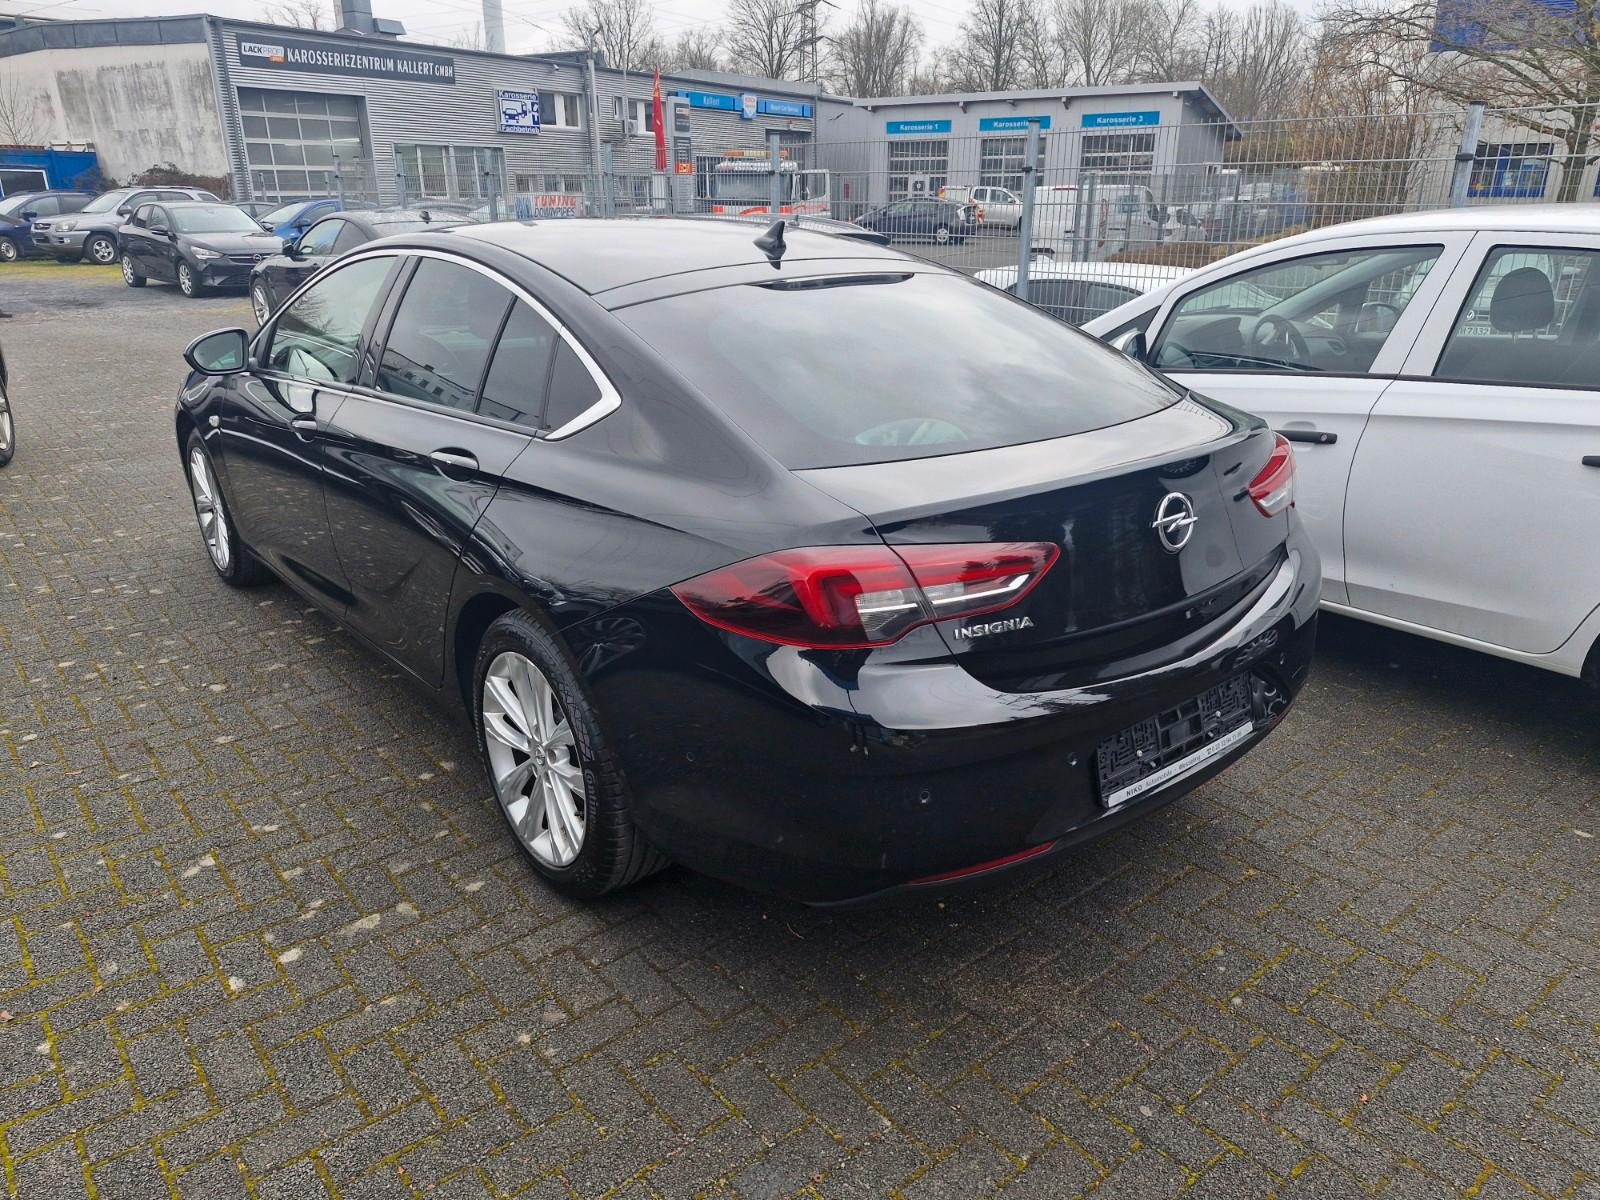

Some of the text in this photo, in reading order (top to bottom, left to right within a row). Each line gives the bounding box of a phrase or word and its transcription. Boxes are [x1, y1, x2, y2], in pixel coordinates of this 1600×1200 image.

[287, 48, 394, 72] KAROSSERIEZENTRUM
[397, 59, 434, 75] KALLERT
[499, 90, 537, 100] Karosserie
[1097, 116, 1136, 124] Karosserie
[501, 124, 540, 133] Fachbetrieb
[900, 123, 933, 131] Karosserie
[533, 195, 576, 207] TUNING
[954, 616, 1034, 639] INSIGNIA
[1126, 785, 1143, 797] NIKO
